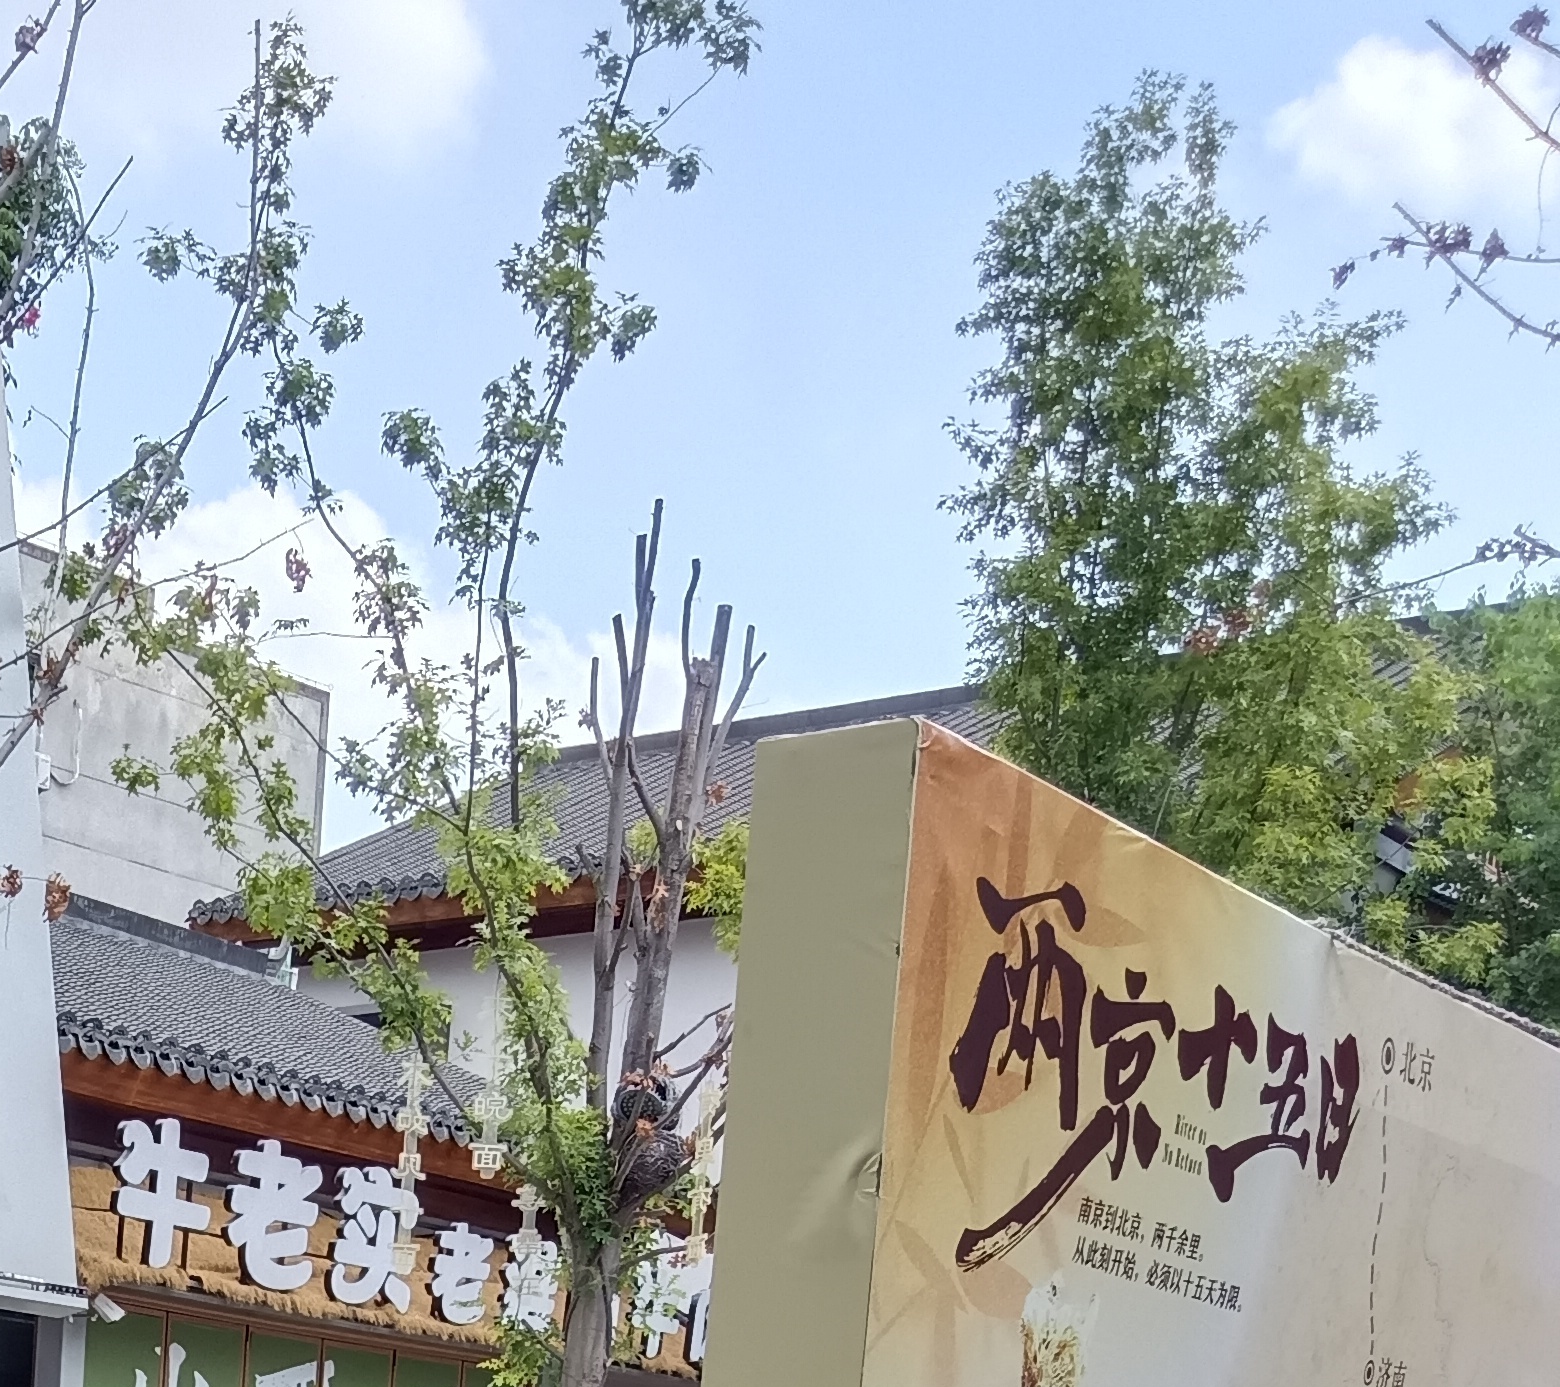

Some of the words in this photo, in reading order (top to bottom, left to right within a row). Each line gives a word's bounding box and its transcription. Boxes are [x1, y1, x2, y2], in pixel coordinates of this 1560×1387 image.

[949, 876, 1360, 1272] 两京十五日
[1400, 1041, 1434, 1093] 北京
[1175, 1114, 1197, 1141] River
[1175, 1147, 1203, 1175] Return
